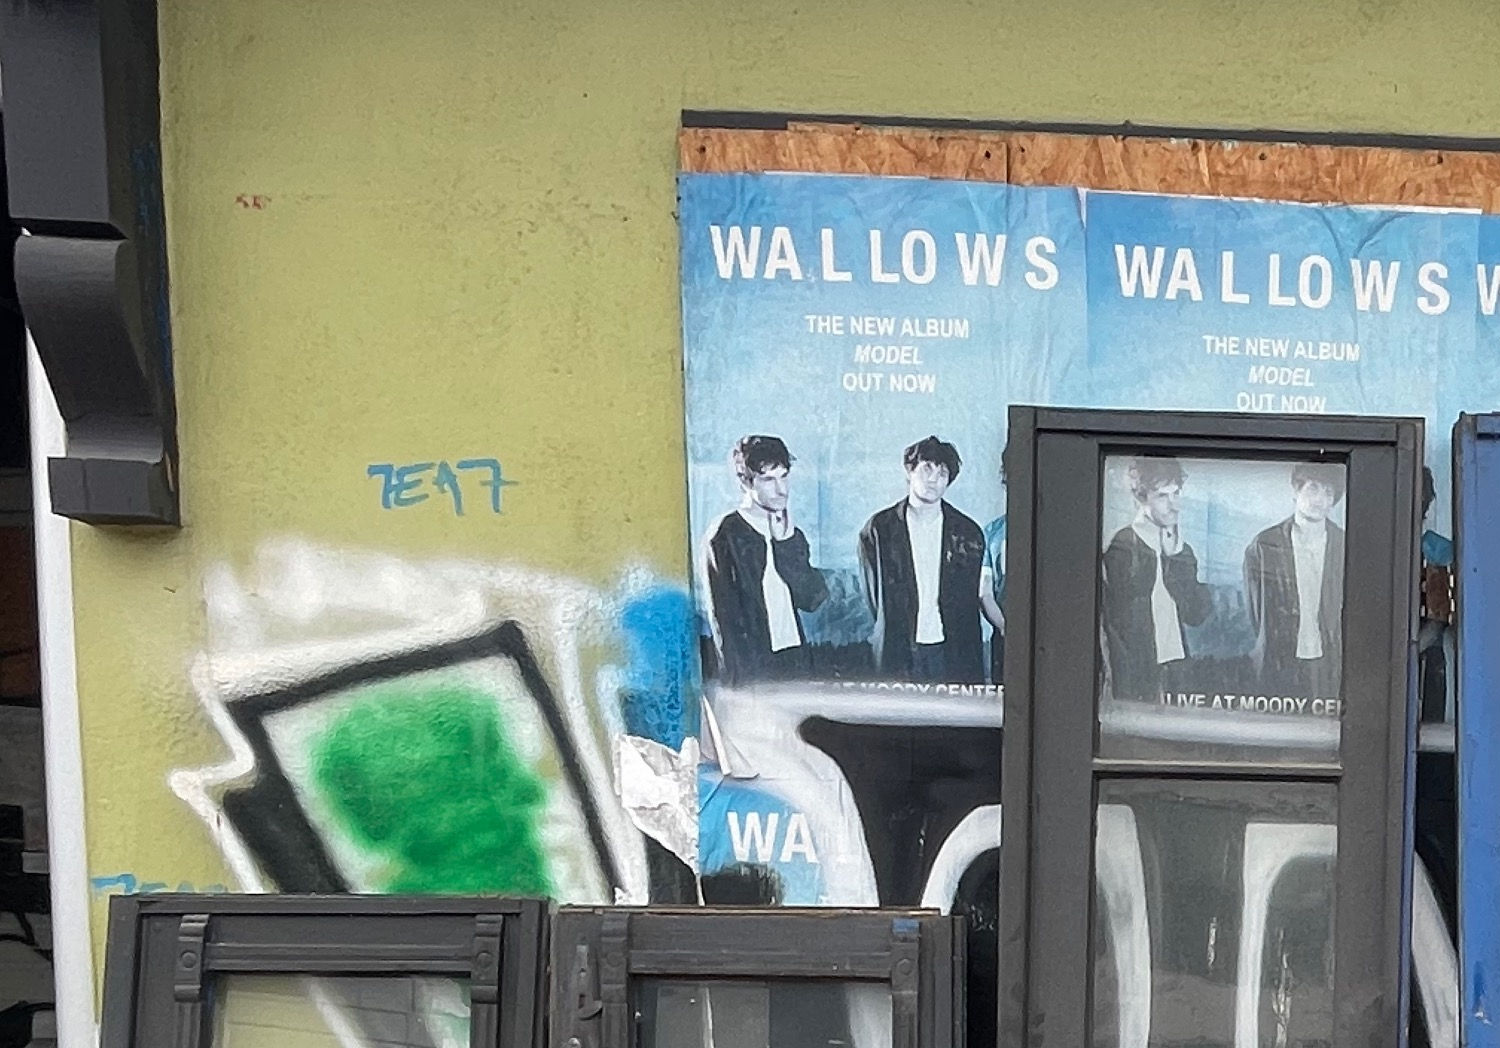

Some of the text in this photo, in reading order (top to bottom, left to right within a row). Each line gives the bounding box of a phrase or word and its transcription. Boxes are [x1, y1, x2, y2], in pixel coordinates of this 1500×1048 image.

[710, 225, 1059, 290] WALLOWS
[1114, 244, 1450, 316] WALLOWS
[805, 315, 969, 338] THE NEW ALBUM
[854, 345, 924, 365] MODEL
[1202, 335, 1360, 362] THE NEW ALBUM
[843, 372, 936, 393] OUT NOW
[1248, 365, 1315, 387] MODEL
[1236, 391, 1327, 413] OUT NOW
[1212, 695, 1236, 713] AT
[1239, 696, 1307, 715] MOODY
